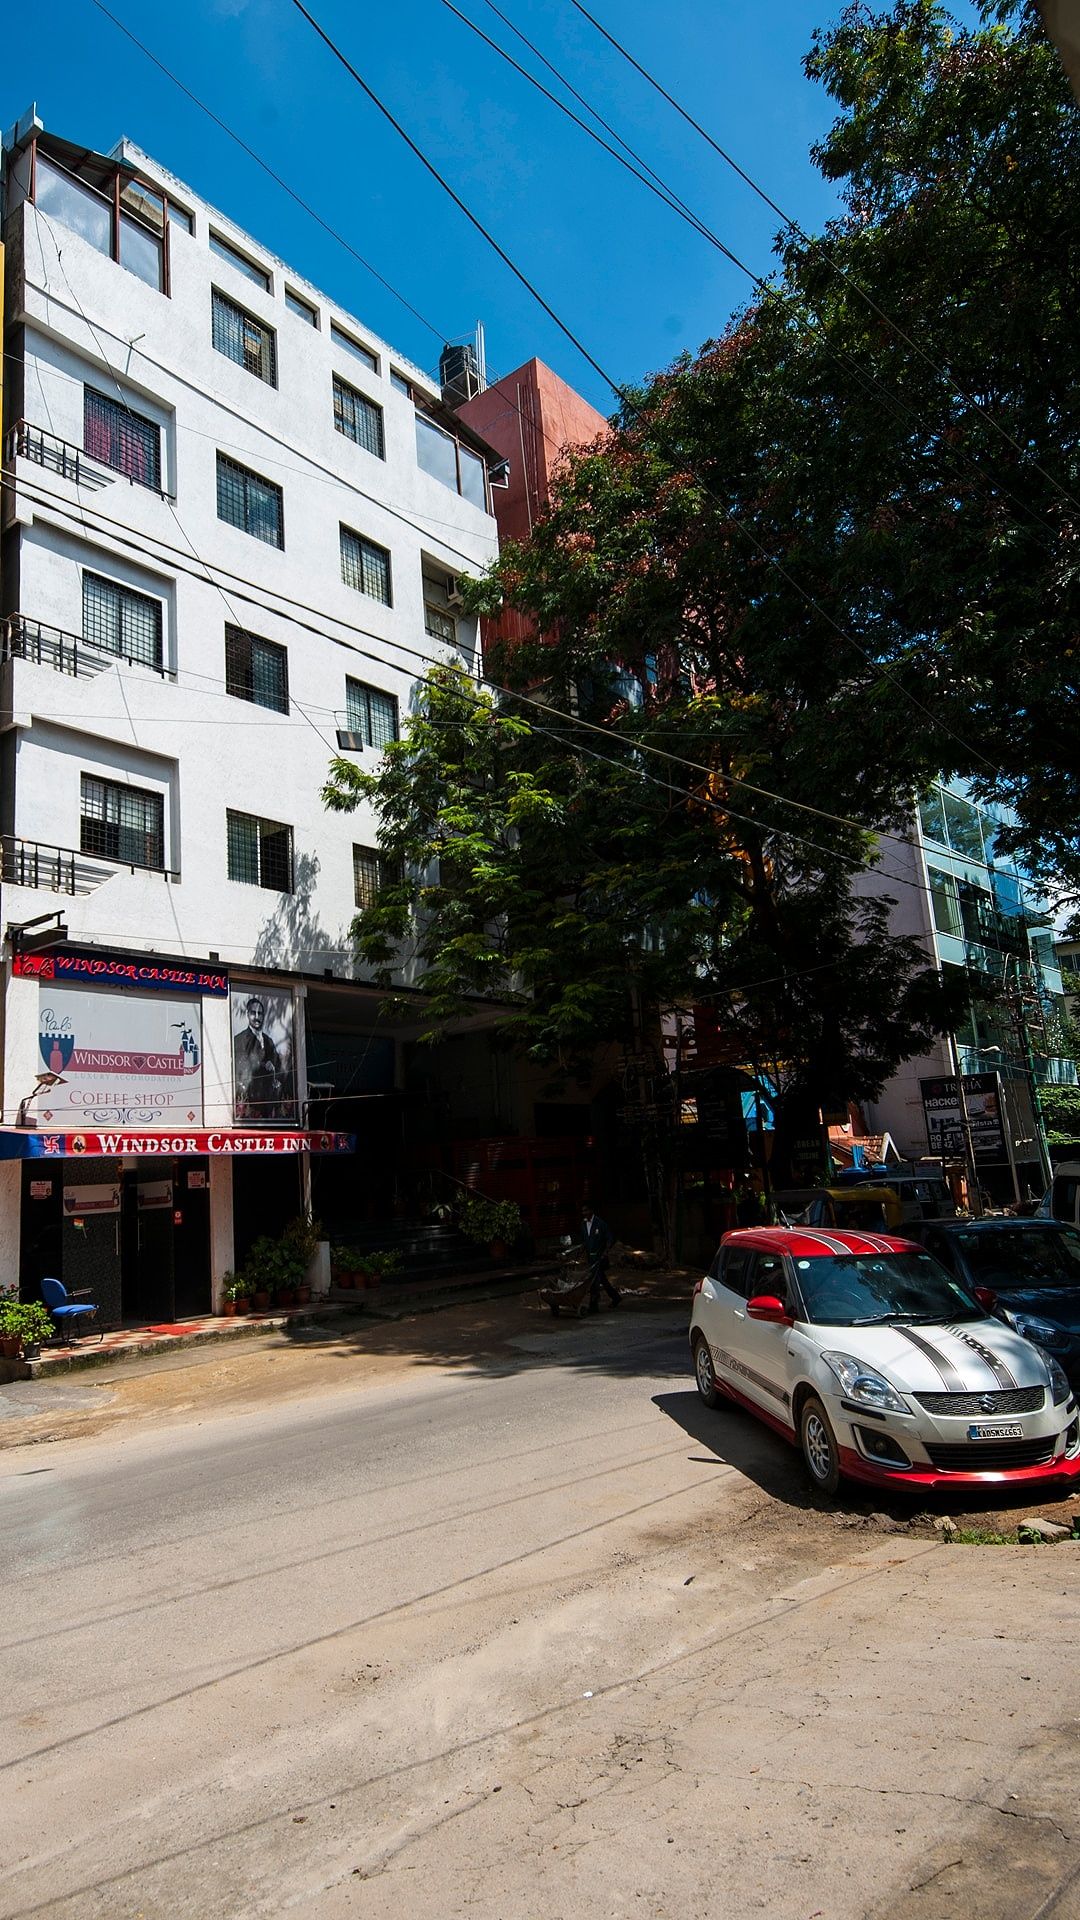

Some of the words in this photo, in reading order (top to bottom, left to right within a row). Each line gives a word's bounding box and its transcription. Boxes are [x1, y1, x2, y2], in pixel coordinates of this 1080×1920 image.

[56, 956, 139, 980] WINDSOR
[140, 967, 197, 985] CASTLE
[197, 974, 228, 990] INN
[40, 1008, 72, 1031] Paul's
[74, 1051, 132, 1067] WINDSOR
[147, 1056, 184, 1069] CASTLE
[944, 1080, 982, 1093] TRSHA
[69, 1090, 128, 1105] COFFEE
[135, 1093, 174, 1106] SHOP
[96, 1133, 199, 1154] WINDSOR
[207, 1134, 274, 1153] CASTLE
[283, 1138, 312, 1151] INN
